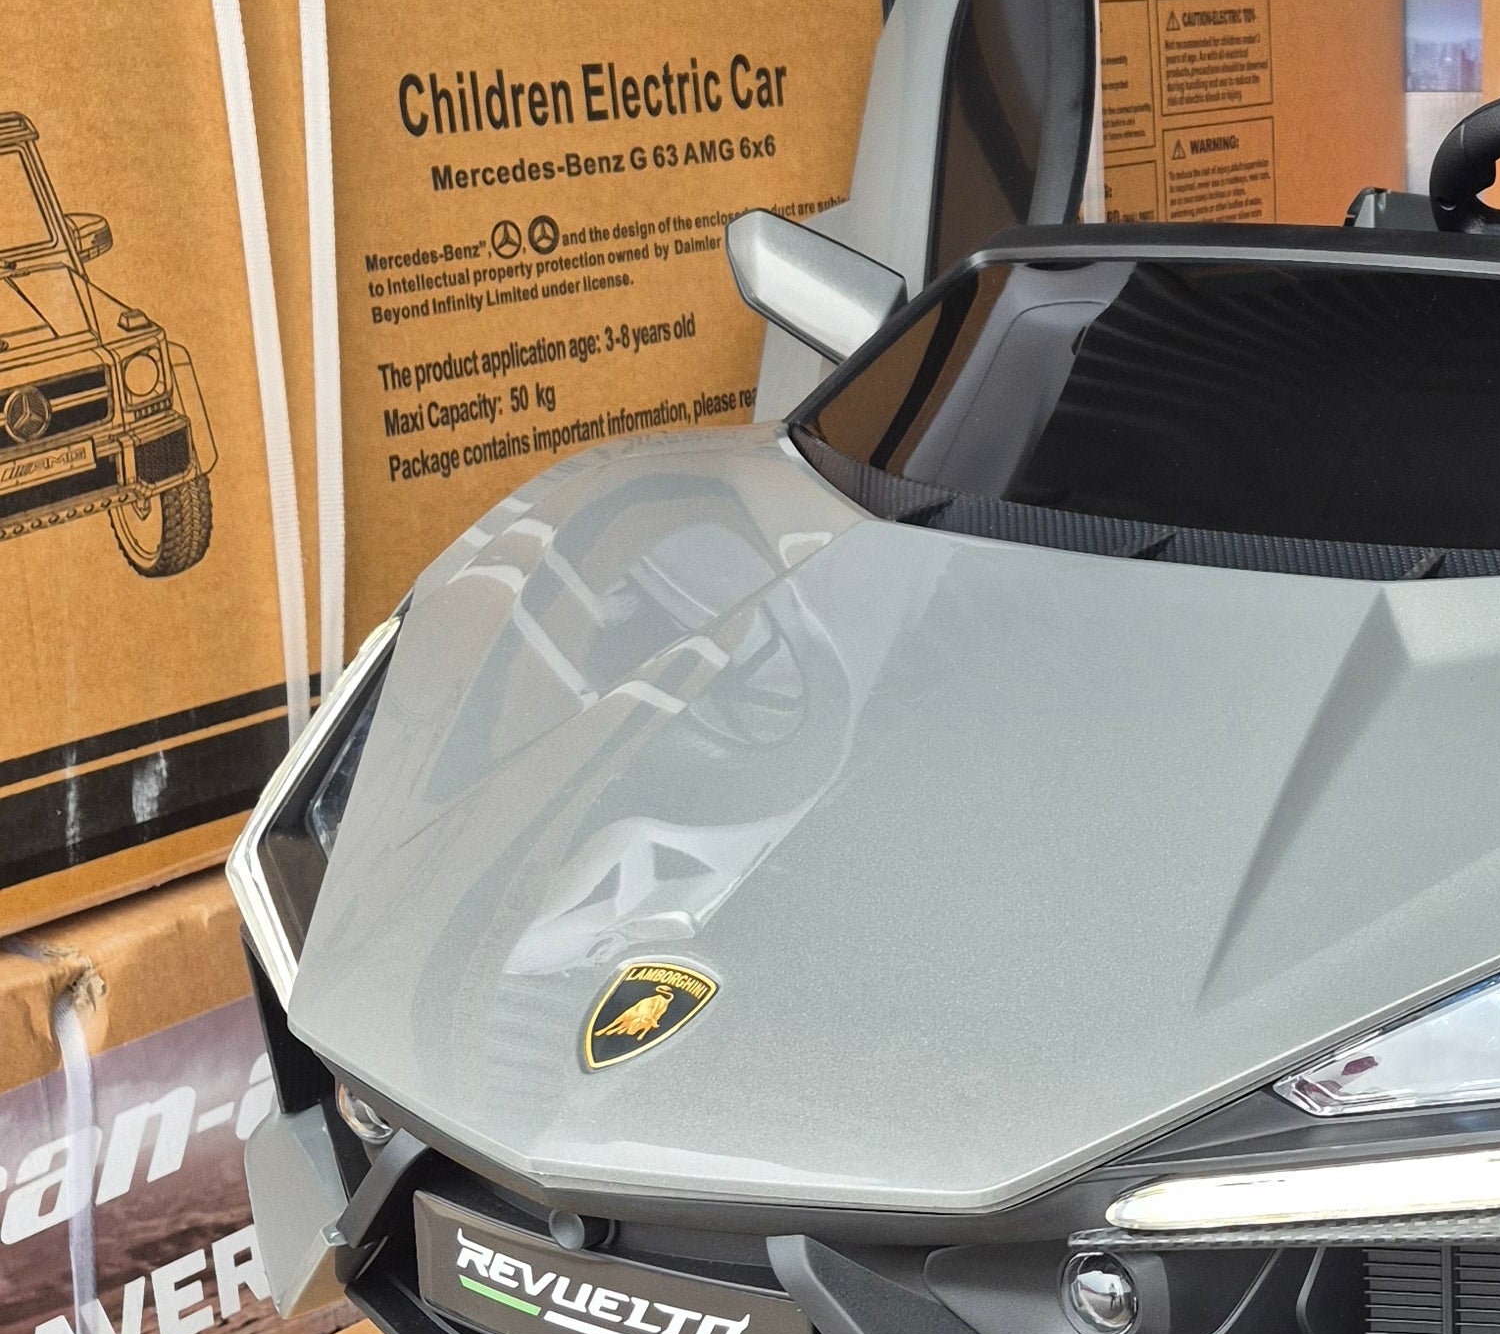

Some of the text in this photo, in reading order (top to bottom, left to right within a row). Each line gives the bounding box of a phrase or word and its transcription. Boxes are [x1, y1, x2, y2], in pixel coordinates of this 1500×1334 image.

[399, 54, 786, 137] Children Electric Car
[432, 135, 775, 191] Mercedes-Benz G 63 AMG 6x6
[562, 228, 586, 246] and
[589, 226, 610, 242] the
[613, 221, 655, 239] design
[658, 217, 670, 233] of
[673, 216, 692, 231] the
[369, 235, 721, 297] to Intellectual property protection owned by Daimler
[372, 274, 634, 324] Beyond Infinity Limited under license.
[378, 313, 695, 392] The product application age: 3-8 years old
[384, 382, 556, 437] Maxi Capacity: 50 kg
[389, 449, 459, 482] Package
[464, 432, 530, 466] contains
[533, 414, 605, 454] important
[607, 402, 691, 435] information,
[694, 393, 736, 423] please
[625, 963, 714, 1001] LAMBORGHINI
